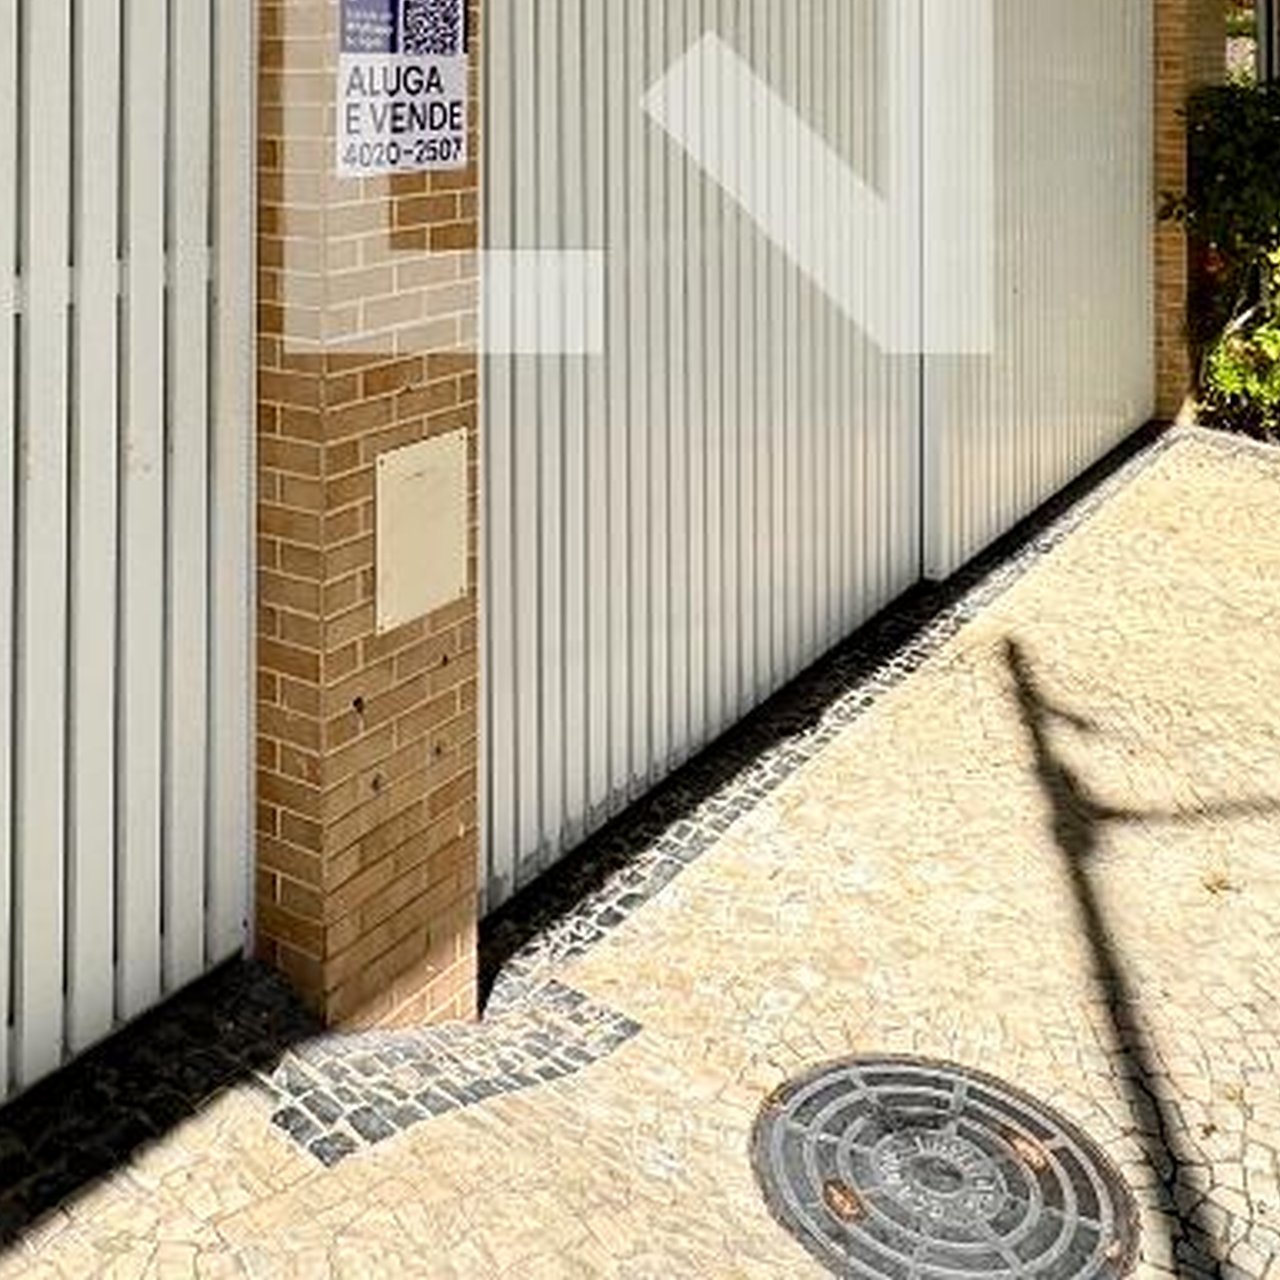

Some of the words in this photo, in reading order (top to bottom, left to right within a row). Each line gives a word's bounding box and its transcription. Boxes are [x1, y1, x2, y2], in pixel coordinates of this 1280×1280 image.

[346, 65, 445, 97] ALUGA
[346, 102, 361, 134] E
[369, 100, 463, 134] VENDE
[343, 137, 463, 168] 4020-2507
